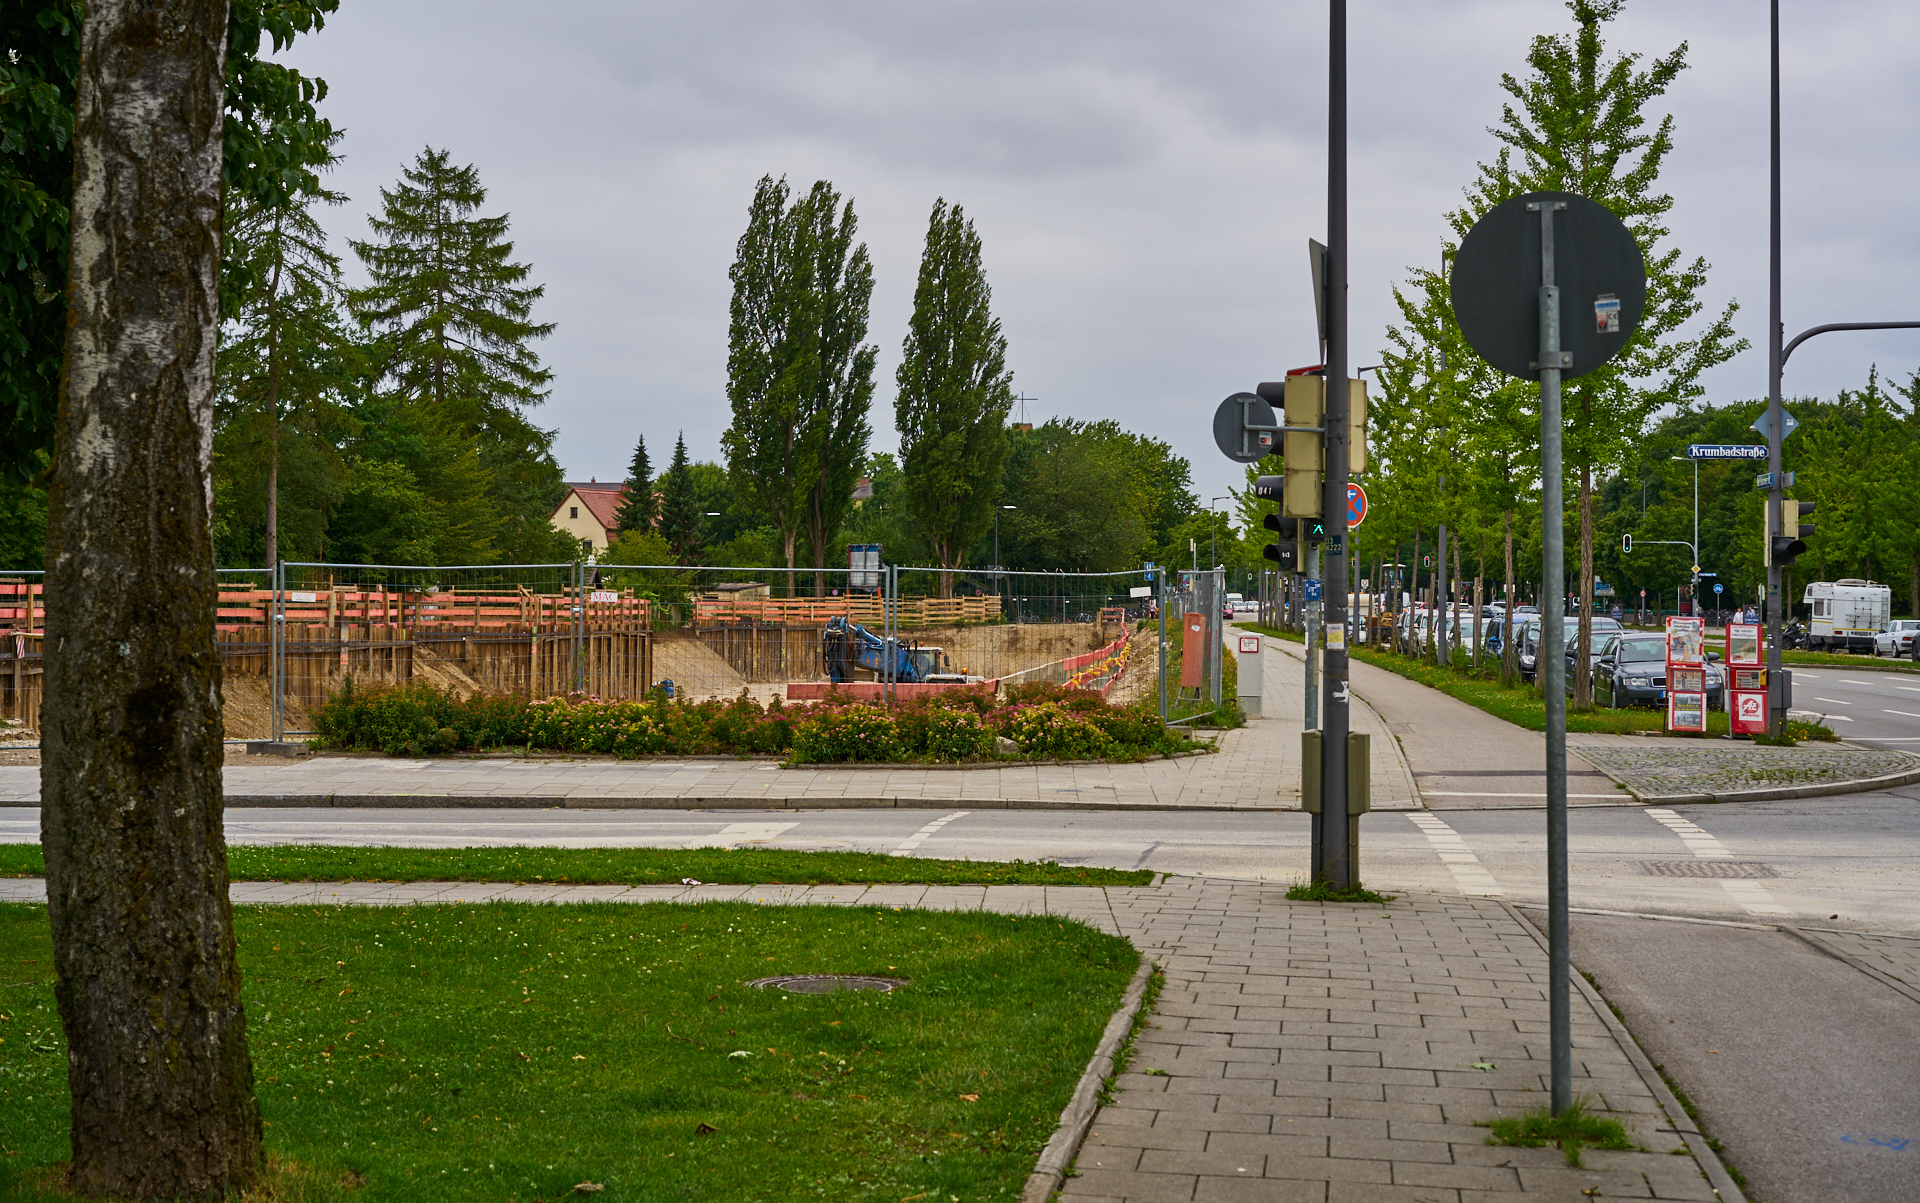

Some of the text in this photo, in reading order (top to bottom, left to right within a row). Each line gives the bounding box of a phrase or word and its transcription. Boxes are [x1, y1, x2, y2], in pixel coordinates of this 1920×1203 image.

[1692, 446, 1765, 458] Krumbadstraße
[1258, 487, 1272, 495] 041
[593, 592, 616, 601] MAC
